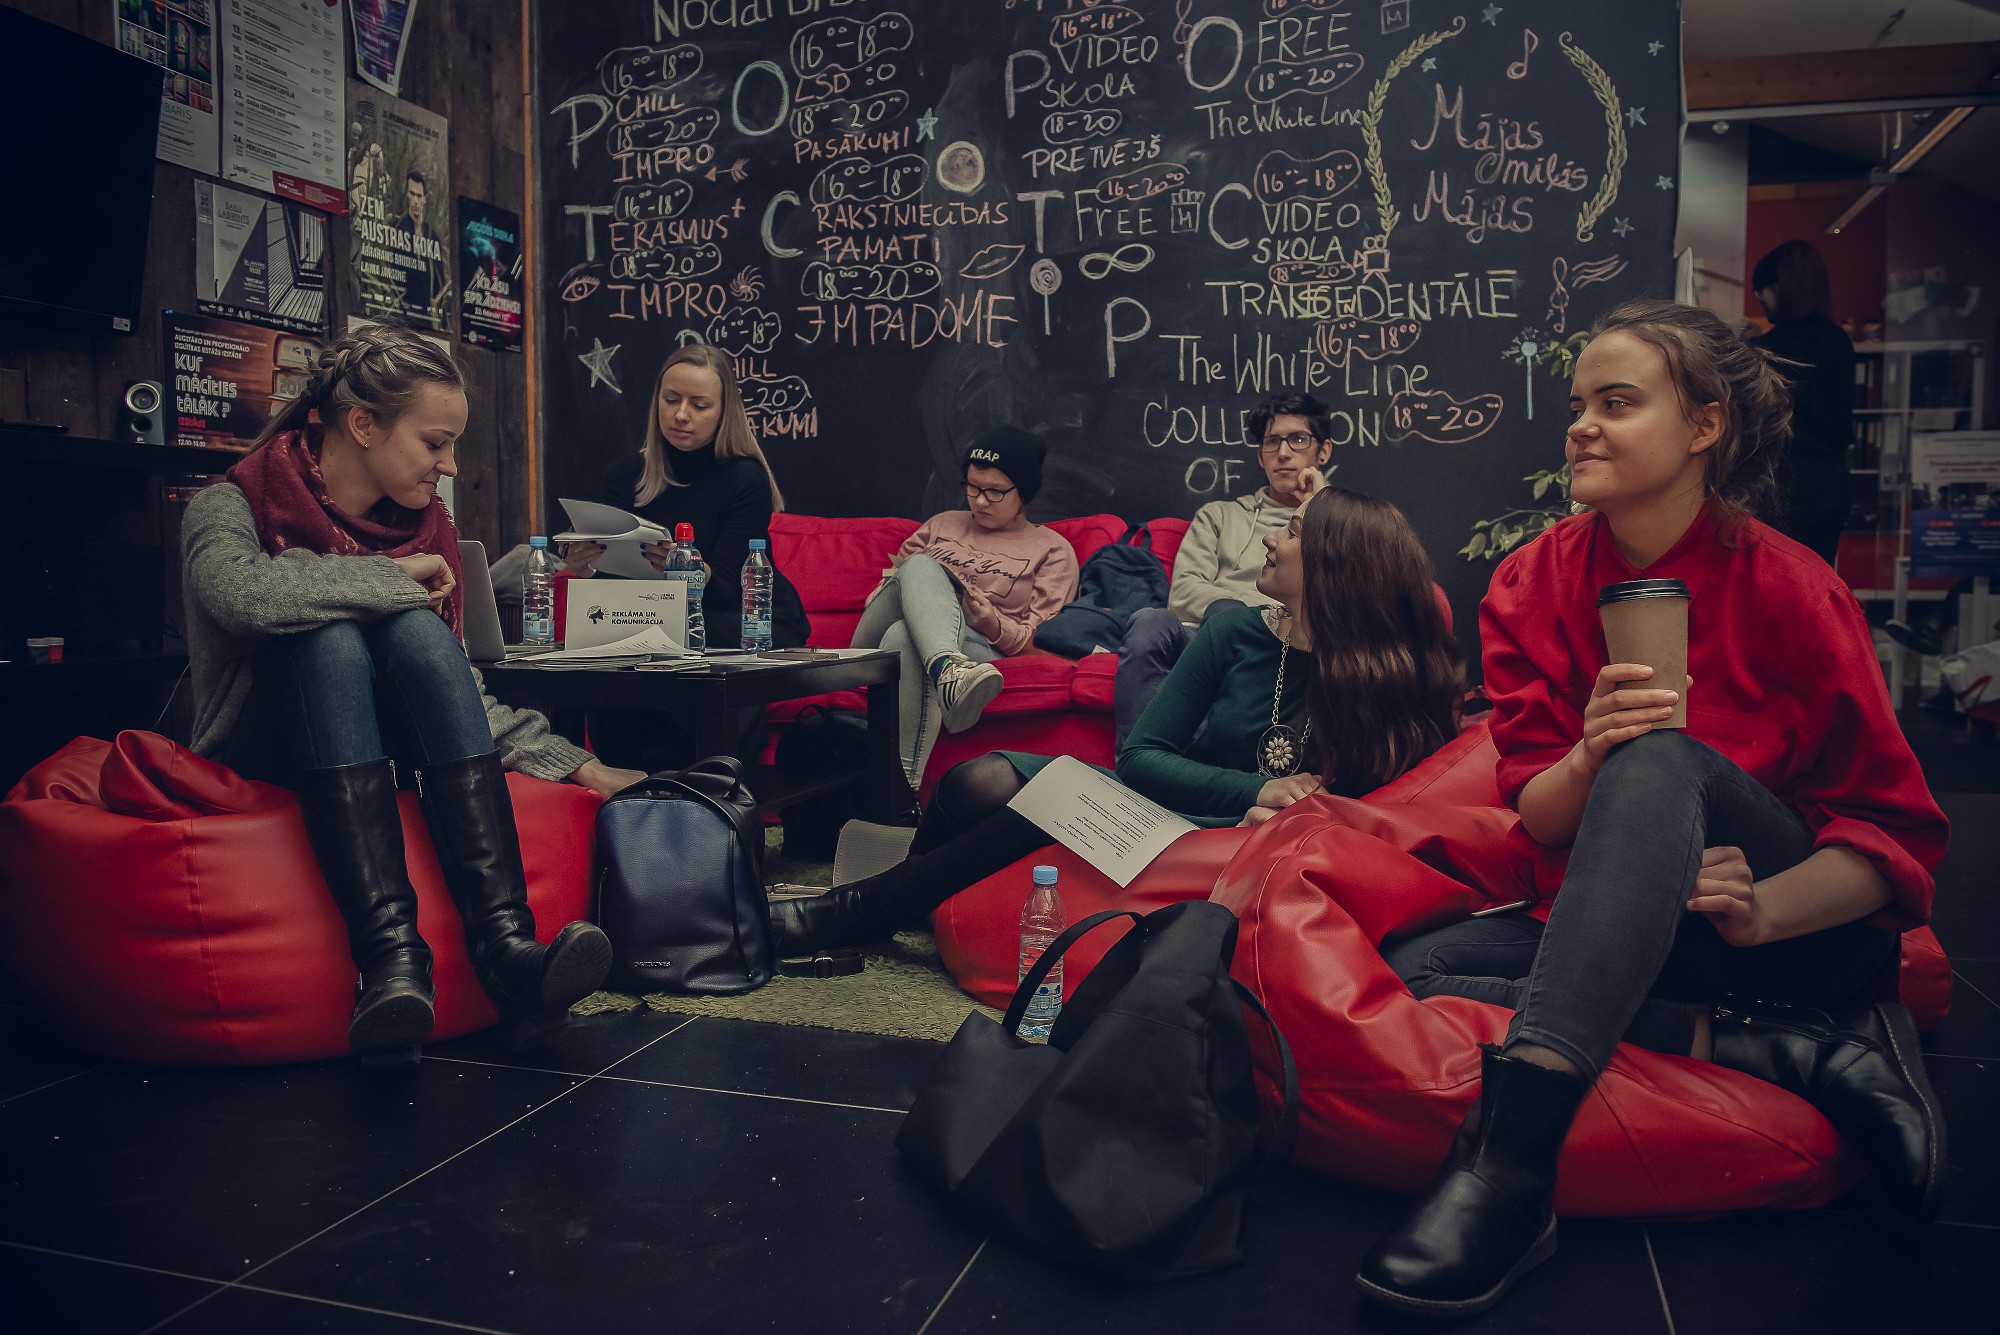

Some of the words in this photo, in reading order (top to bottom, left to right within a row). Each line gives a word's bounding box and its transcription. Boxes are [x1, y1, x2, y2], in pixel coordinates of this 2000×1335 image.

[1056, 35, 1159, 73] VIDEO
[1257, 12, 1353, 64] FREE
[795, 72, 851, 104] LSD
[1004, 49, 1051, 118] P
[615, 93, 685, 122] CHILL
[1193, 100, 1252, 140] The
[550, 94, 613, 168] P
[793, 127, 910, 164] PASĀKUMI
[612, 144, 714, 183] IMPRO
[361, 195, 385, 221] ZEM
[760, 190, 803, 258] C
[1016, 190, 1065, 253] T
[1207, 182, 1253, 250] C
[1262, 200, 1361, 237] VIDEO
[361, 218, 412, 253] AUSTRAS
[413, 233, 441, 262] KOKA
[564, 205, 614, 261] T
[817, 232, 942, 263] PAMATI
[1252, 235, 1346, 264] SKOLA
[606, 284, 726, 319] IMPRO
[865, 289, 1018, 348] PADOME
[1103, 296, 1153, 378] P
[1159, 334, 1227, 385] The
[1233, 331, 1331, 394] White
[1345, 337, 1434, 396] Line
[970, 449, 1000, 463] KRAP
[1184, 457, 1246, 495] OF
[957, 572, 978, 585] OVE
[975, 559, 1016, 579] You
[611, 610, 644, 618] REKLĀMA
